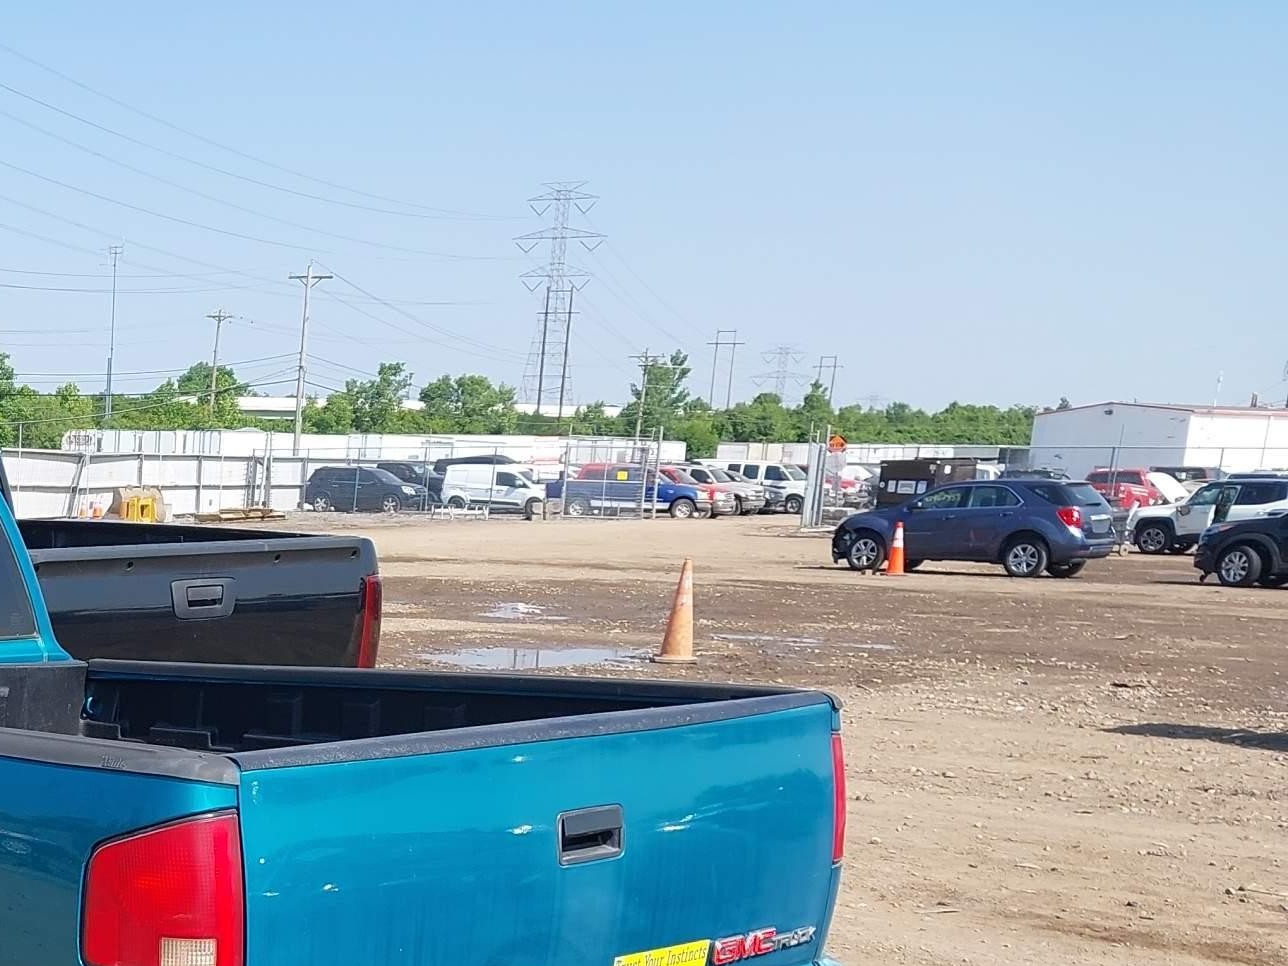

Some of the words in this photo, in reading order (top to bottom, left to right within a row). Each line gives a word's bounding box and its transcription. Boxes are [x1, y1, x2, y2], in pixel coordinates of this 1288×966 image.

[666, 947, 707, 966] Instincts
[714, 927, 776, 966] GMC
[772, 926, 816, 950] TRUCK
